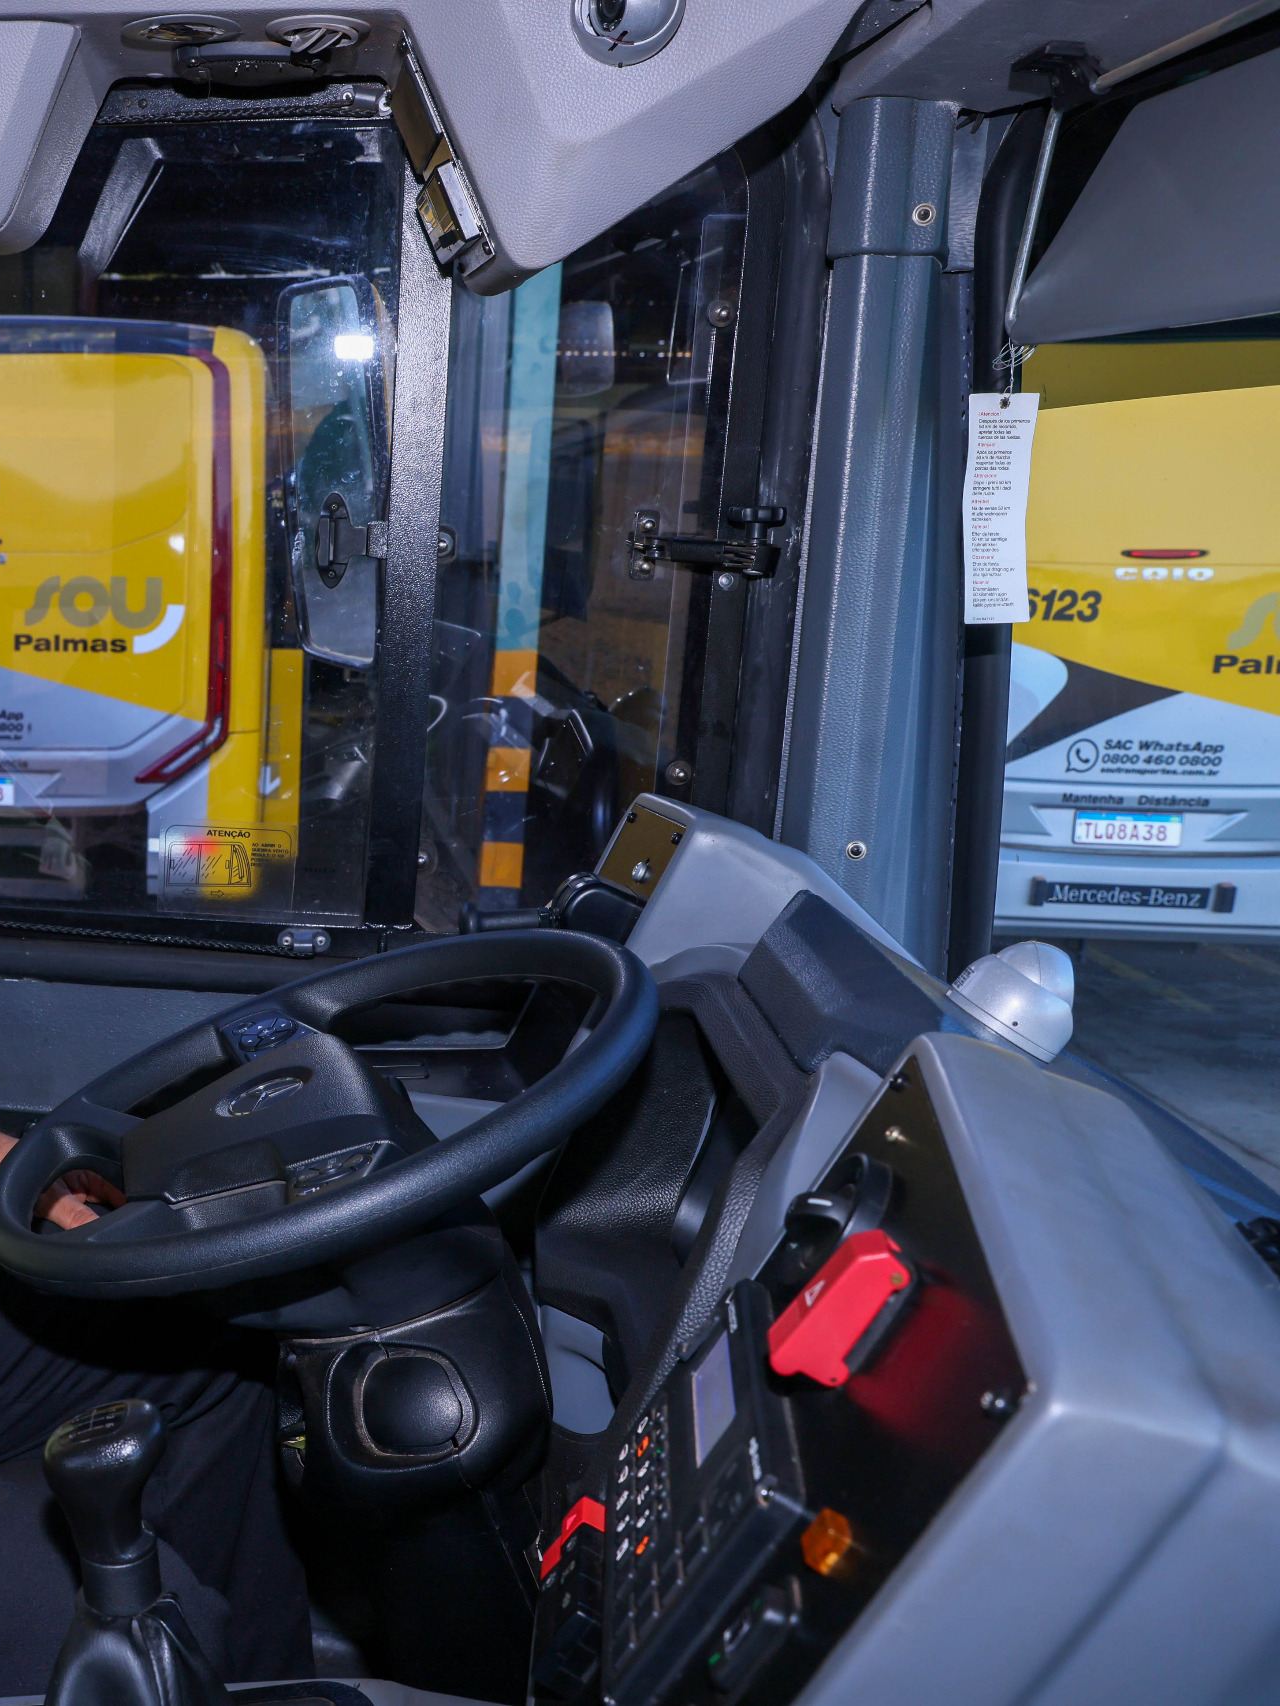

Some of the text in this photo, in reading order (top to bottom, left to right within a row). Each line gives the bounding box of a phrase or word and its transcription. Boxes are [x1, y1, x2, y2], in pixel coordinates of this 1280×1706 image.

[1114, 566, 1215, 582] CAIO
[13, 633, 127, 653] Palmas
[1104, 739, 1225, 754] SAC WhatsApp
[1101, 753, 1223, 767] 0800 460 0800
[1061, 793, 1210, 807] Mantenha Distância
[206, 829, 251, 839] ATENÇÃO
[1084, 822, 1167, 842] TLQ8A38
[1053, 884, 1201, 907] Mercedes-Benz
